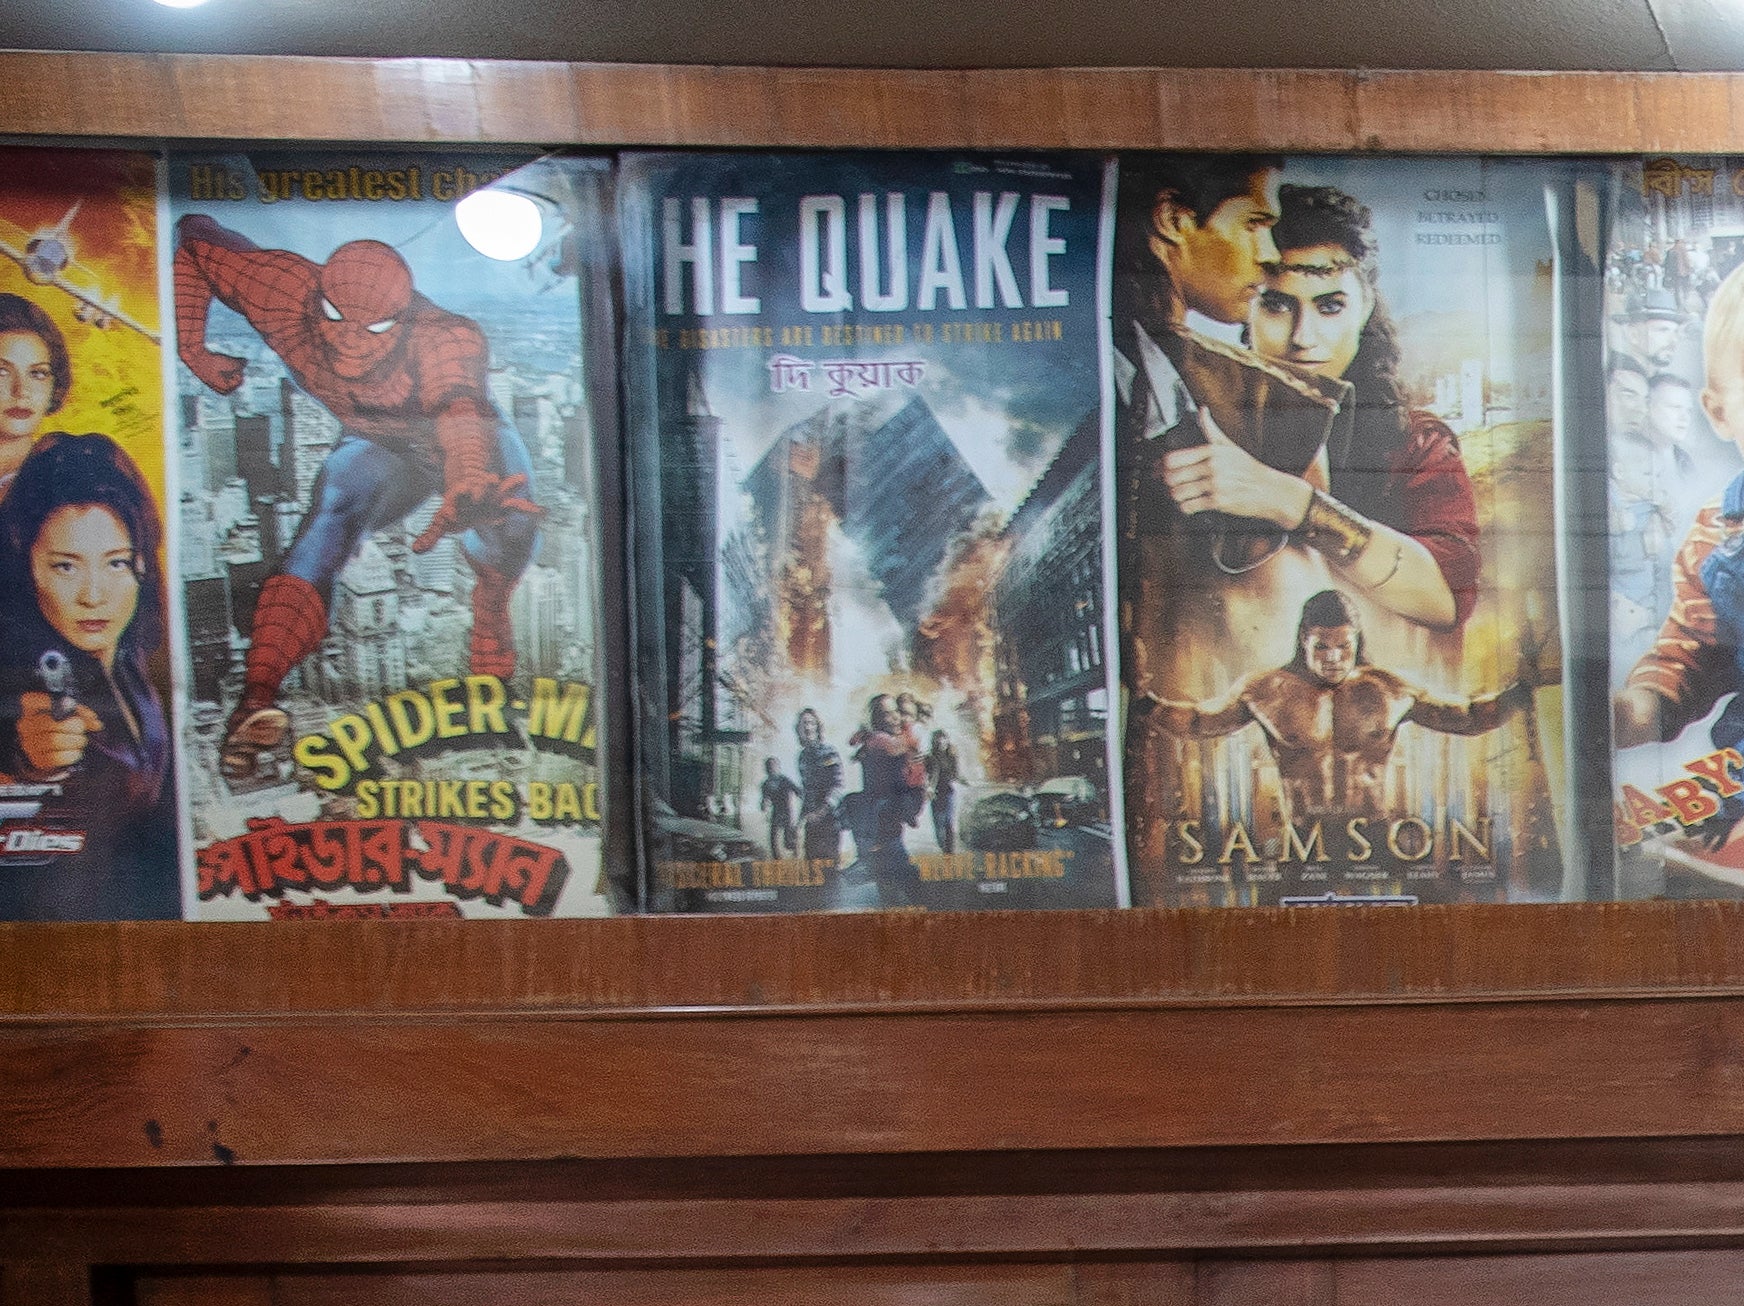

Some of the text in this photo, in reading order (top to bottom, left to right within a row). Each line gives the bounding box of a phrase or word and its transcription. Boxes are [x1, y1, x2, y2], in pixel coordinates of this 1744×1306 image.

[260, 166, 420, 205] greatest
[662, 191, 1071, 317] HE QUAKE
[292, 674, 599, 791] SPIDER-M
[356, 780, 600, 822] STRIKES BAC
[1177, 816, 1494, 866] SAMSON
